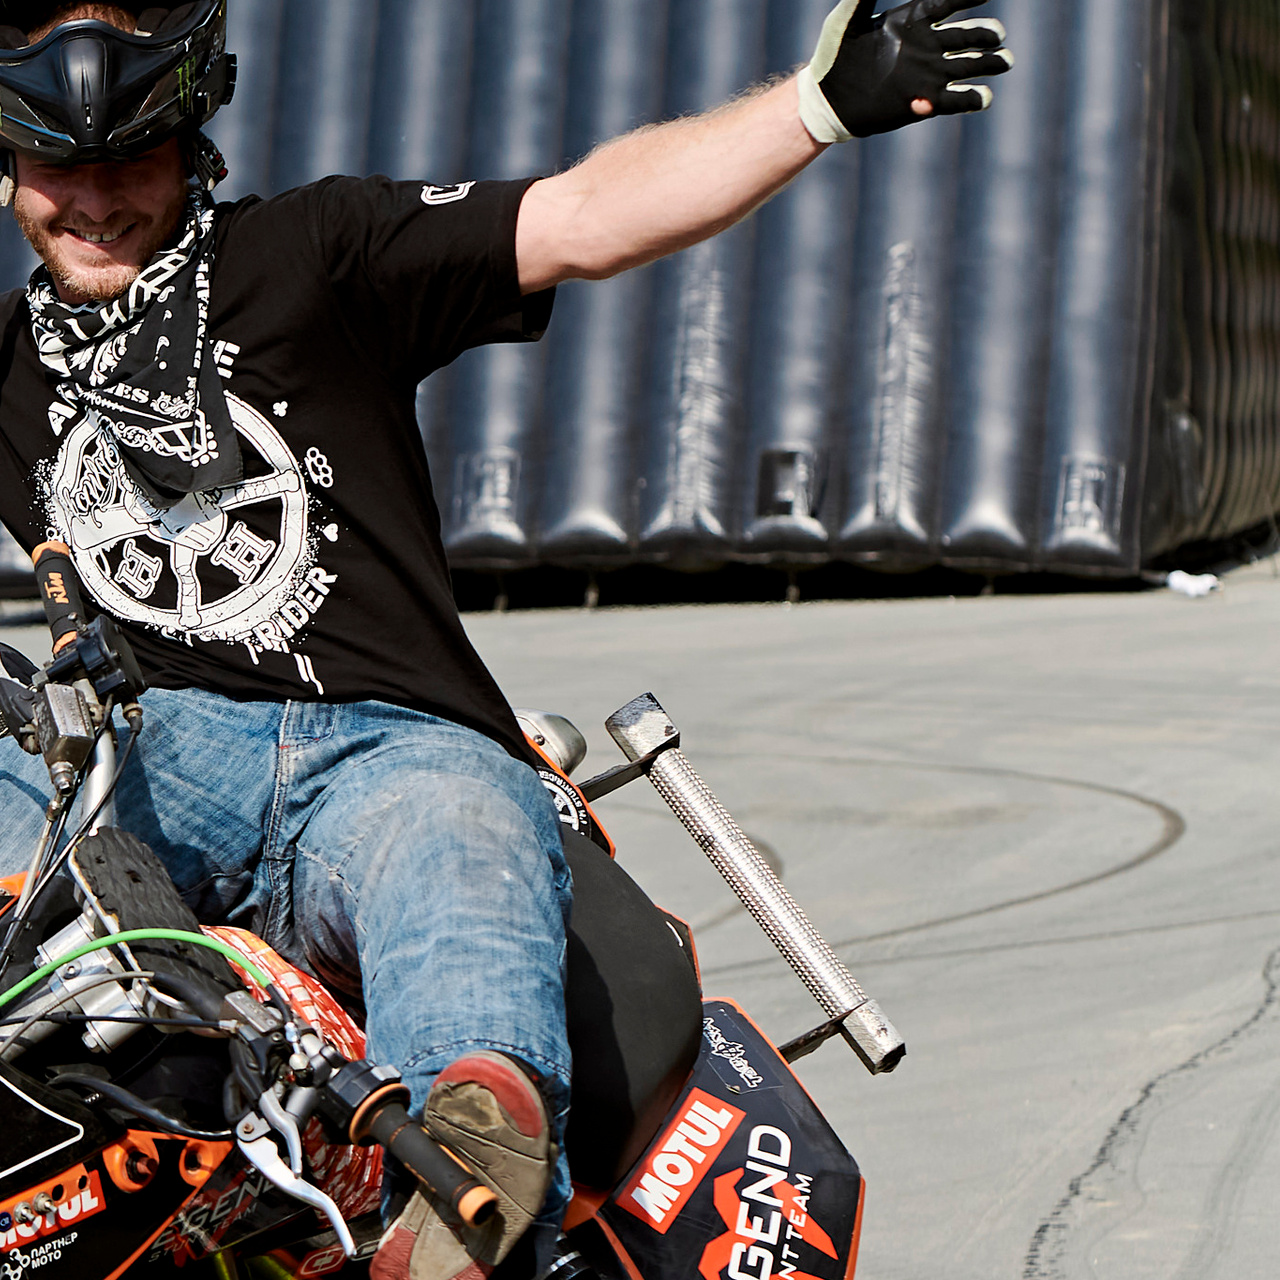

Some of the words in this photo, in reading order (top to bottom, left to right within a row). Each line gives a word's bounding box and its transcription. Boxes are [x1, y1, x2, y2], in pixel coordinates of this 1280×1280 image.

[48, 572, 70, 604] KTM
[633, 1099, 734, 1223] MOTUL
[785, 1172, 814, 1240] TEAM
[30, 1231, 79, 1259] ПАРТНЕР
[31, 1250, 62, 1270] МОТО
